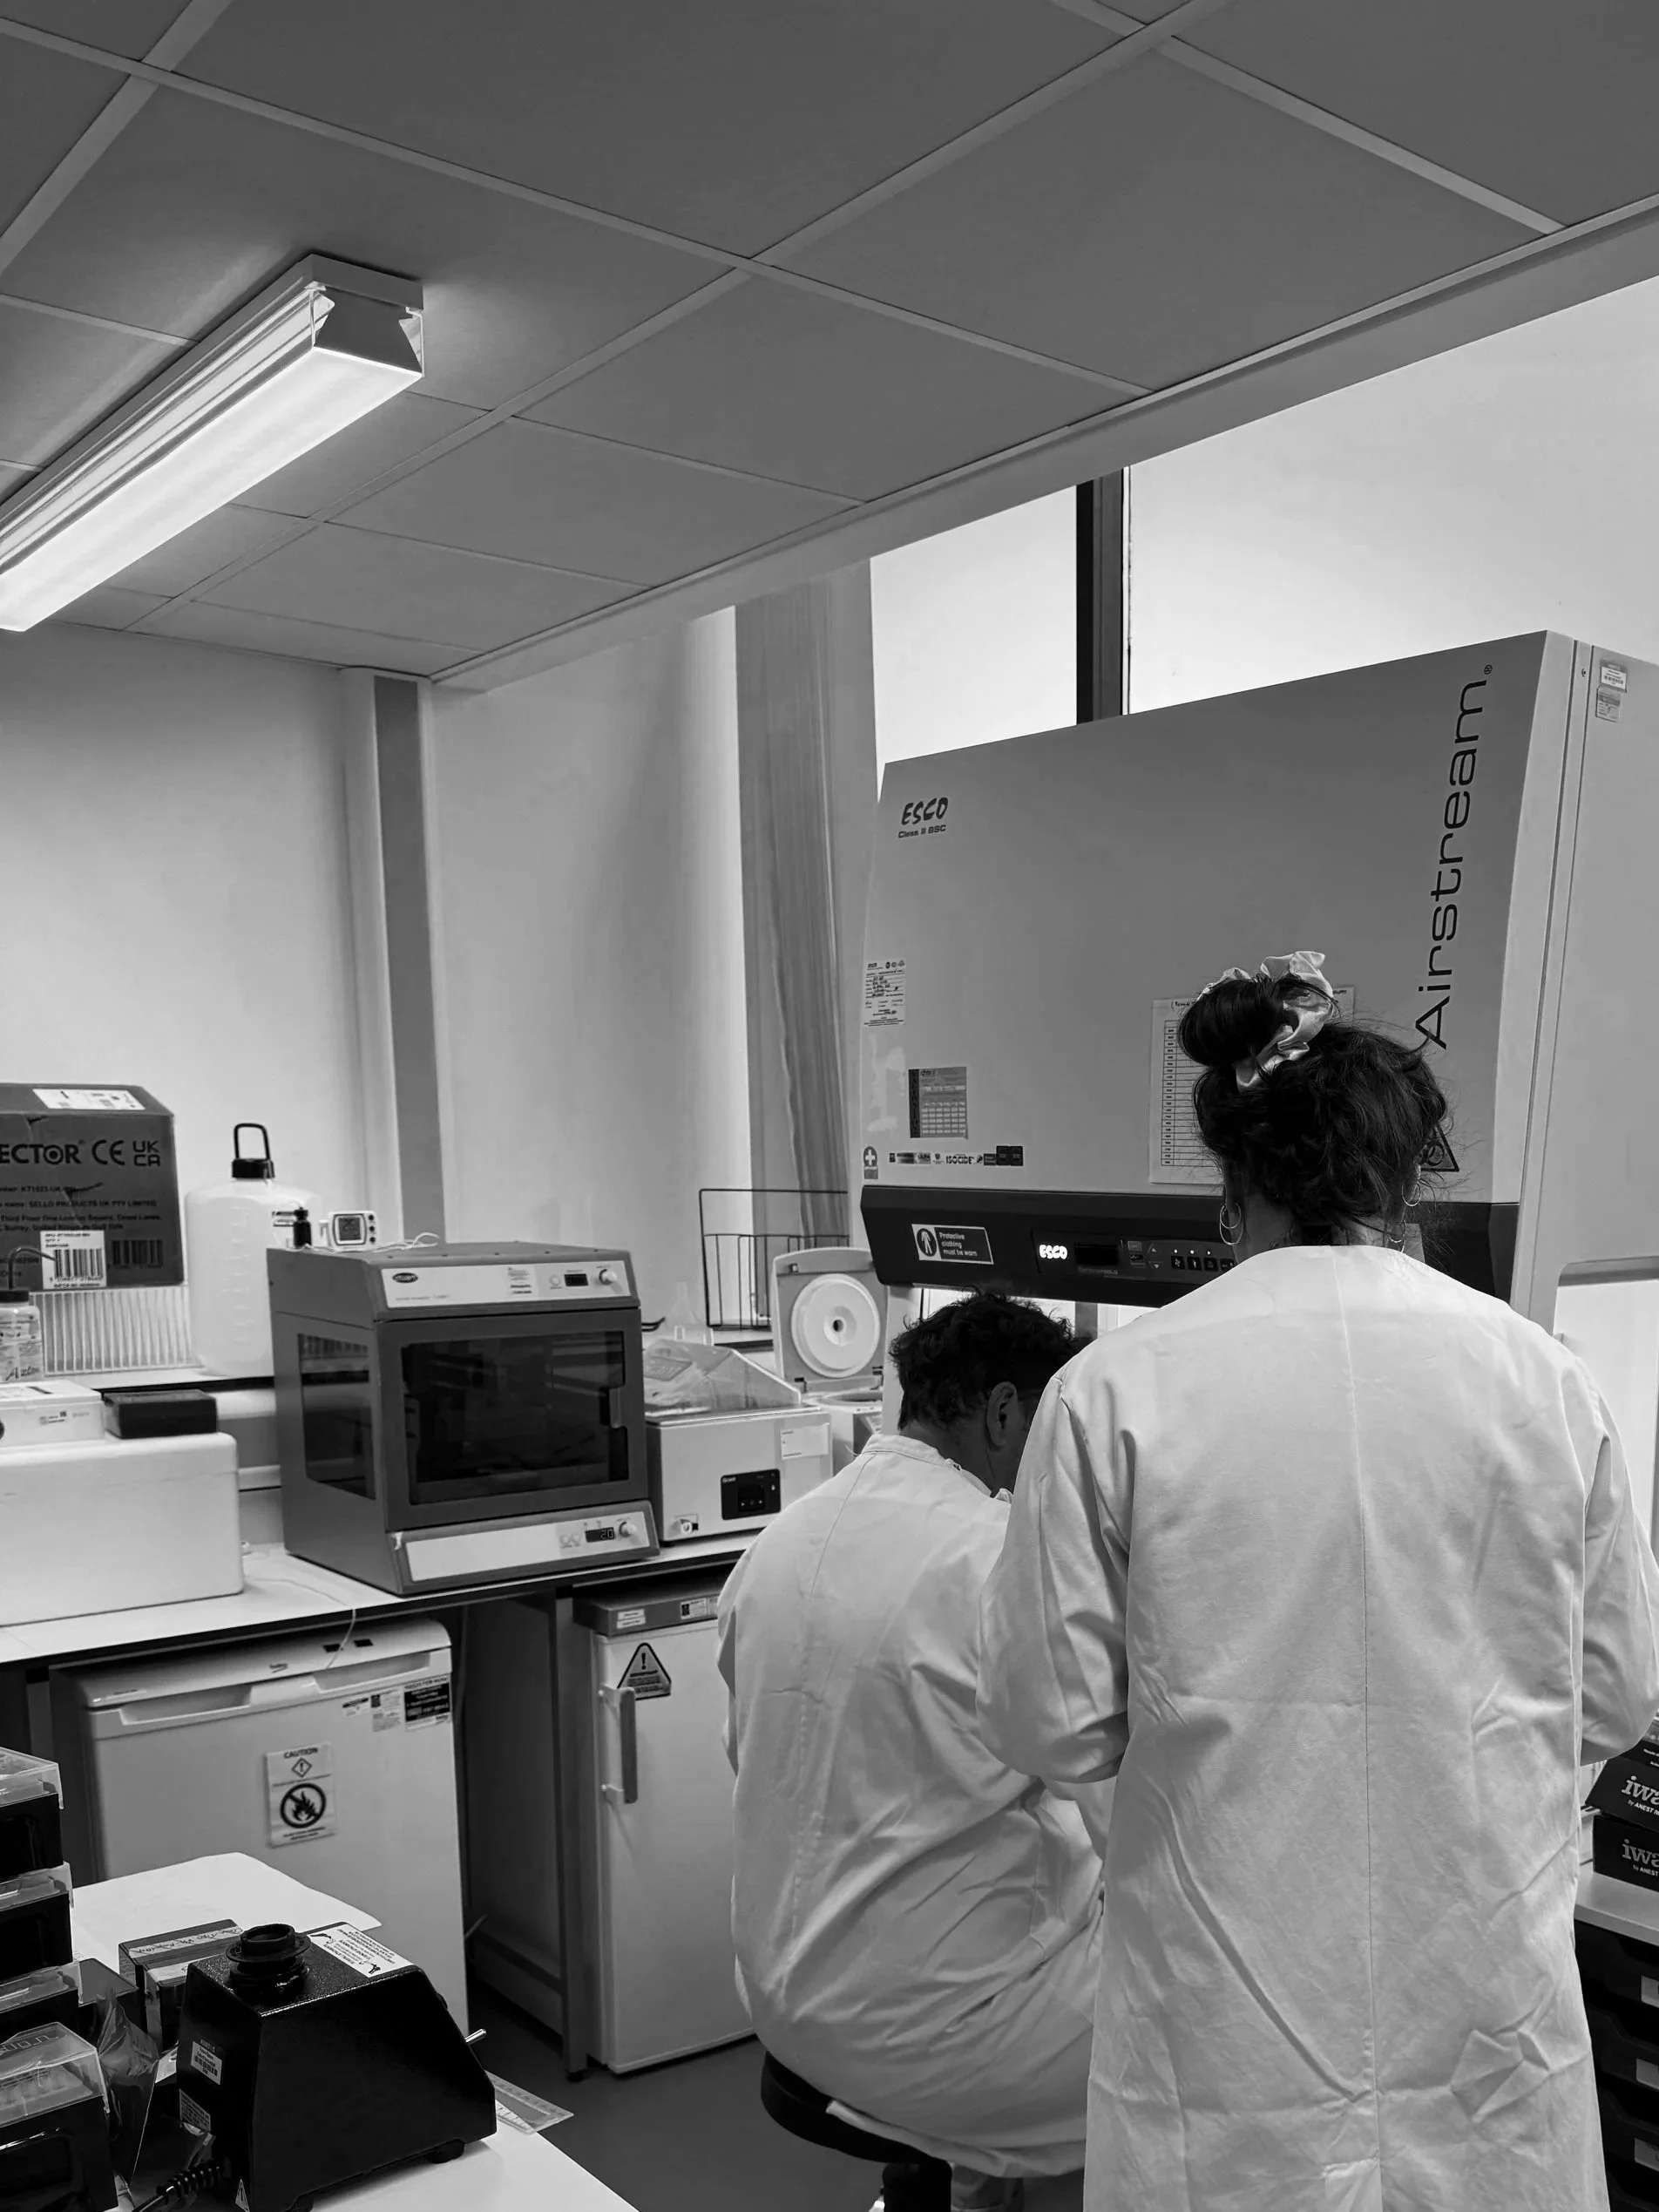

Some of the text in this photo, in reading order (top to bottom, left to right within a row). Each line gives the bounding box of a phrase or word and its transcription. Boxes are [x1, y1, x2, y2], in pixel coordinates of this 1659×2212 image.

[902, 797, 948, 825] ESCO
[928, 824, 946, 834] BSC
[132, 1140, 159, 1153] UK
[133, 1154, 160, 1167] CA
[939, 1232, 965, 1240] Protective
[941, 1240, 963, 1250] clothing
[1039, 1244, 1068, 1260] ESCO
[283, 1747, 319, 1759] CAUTION
